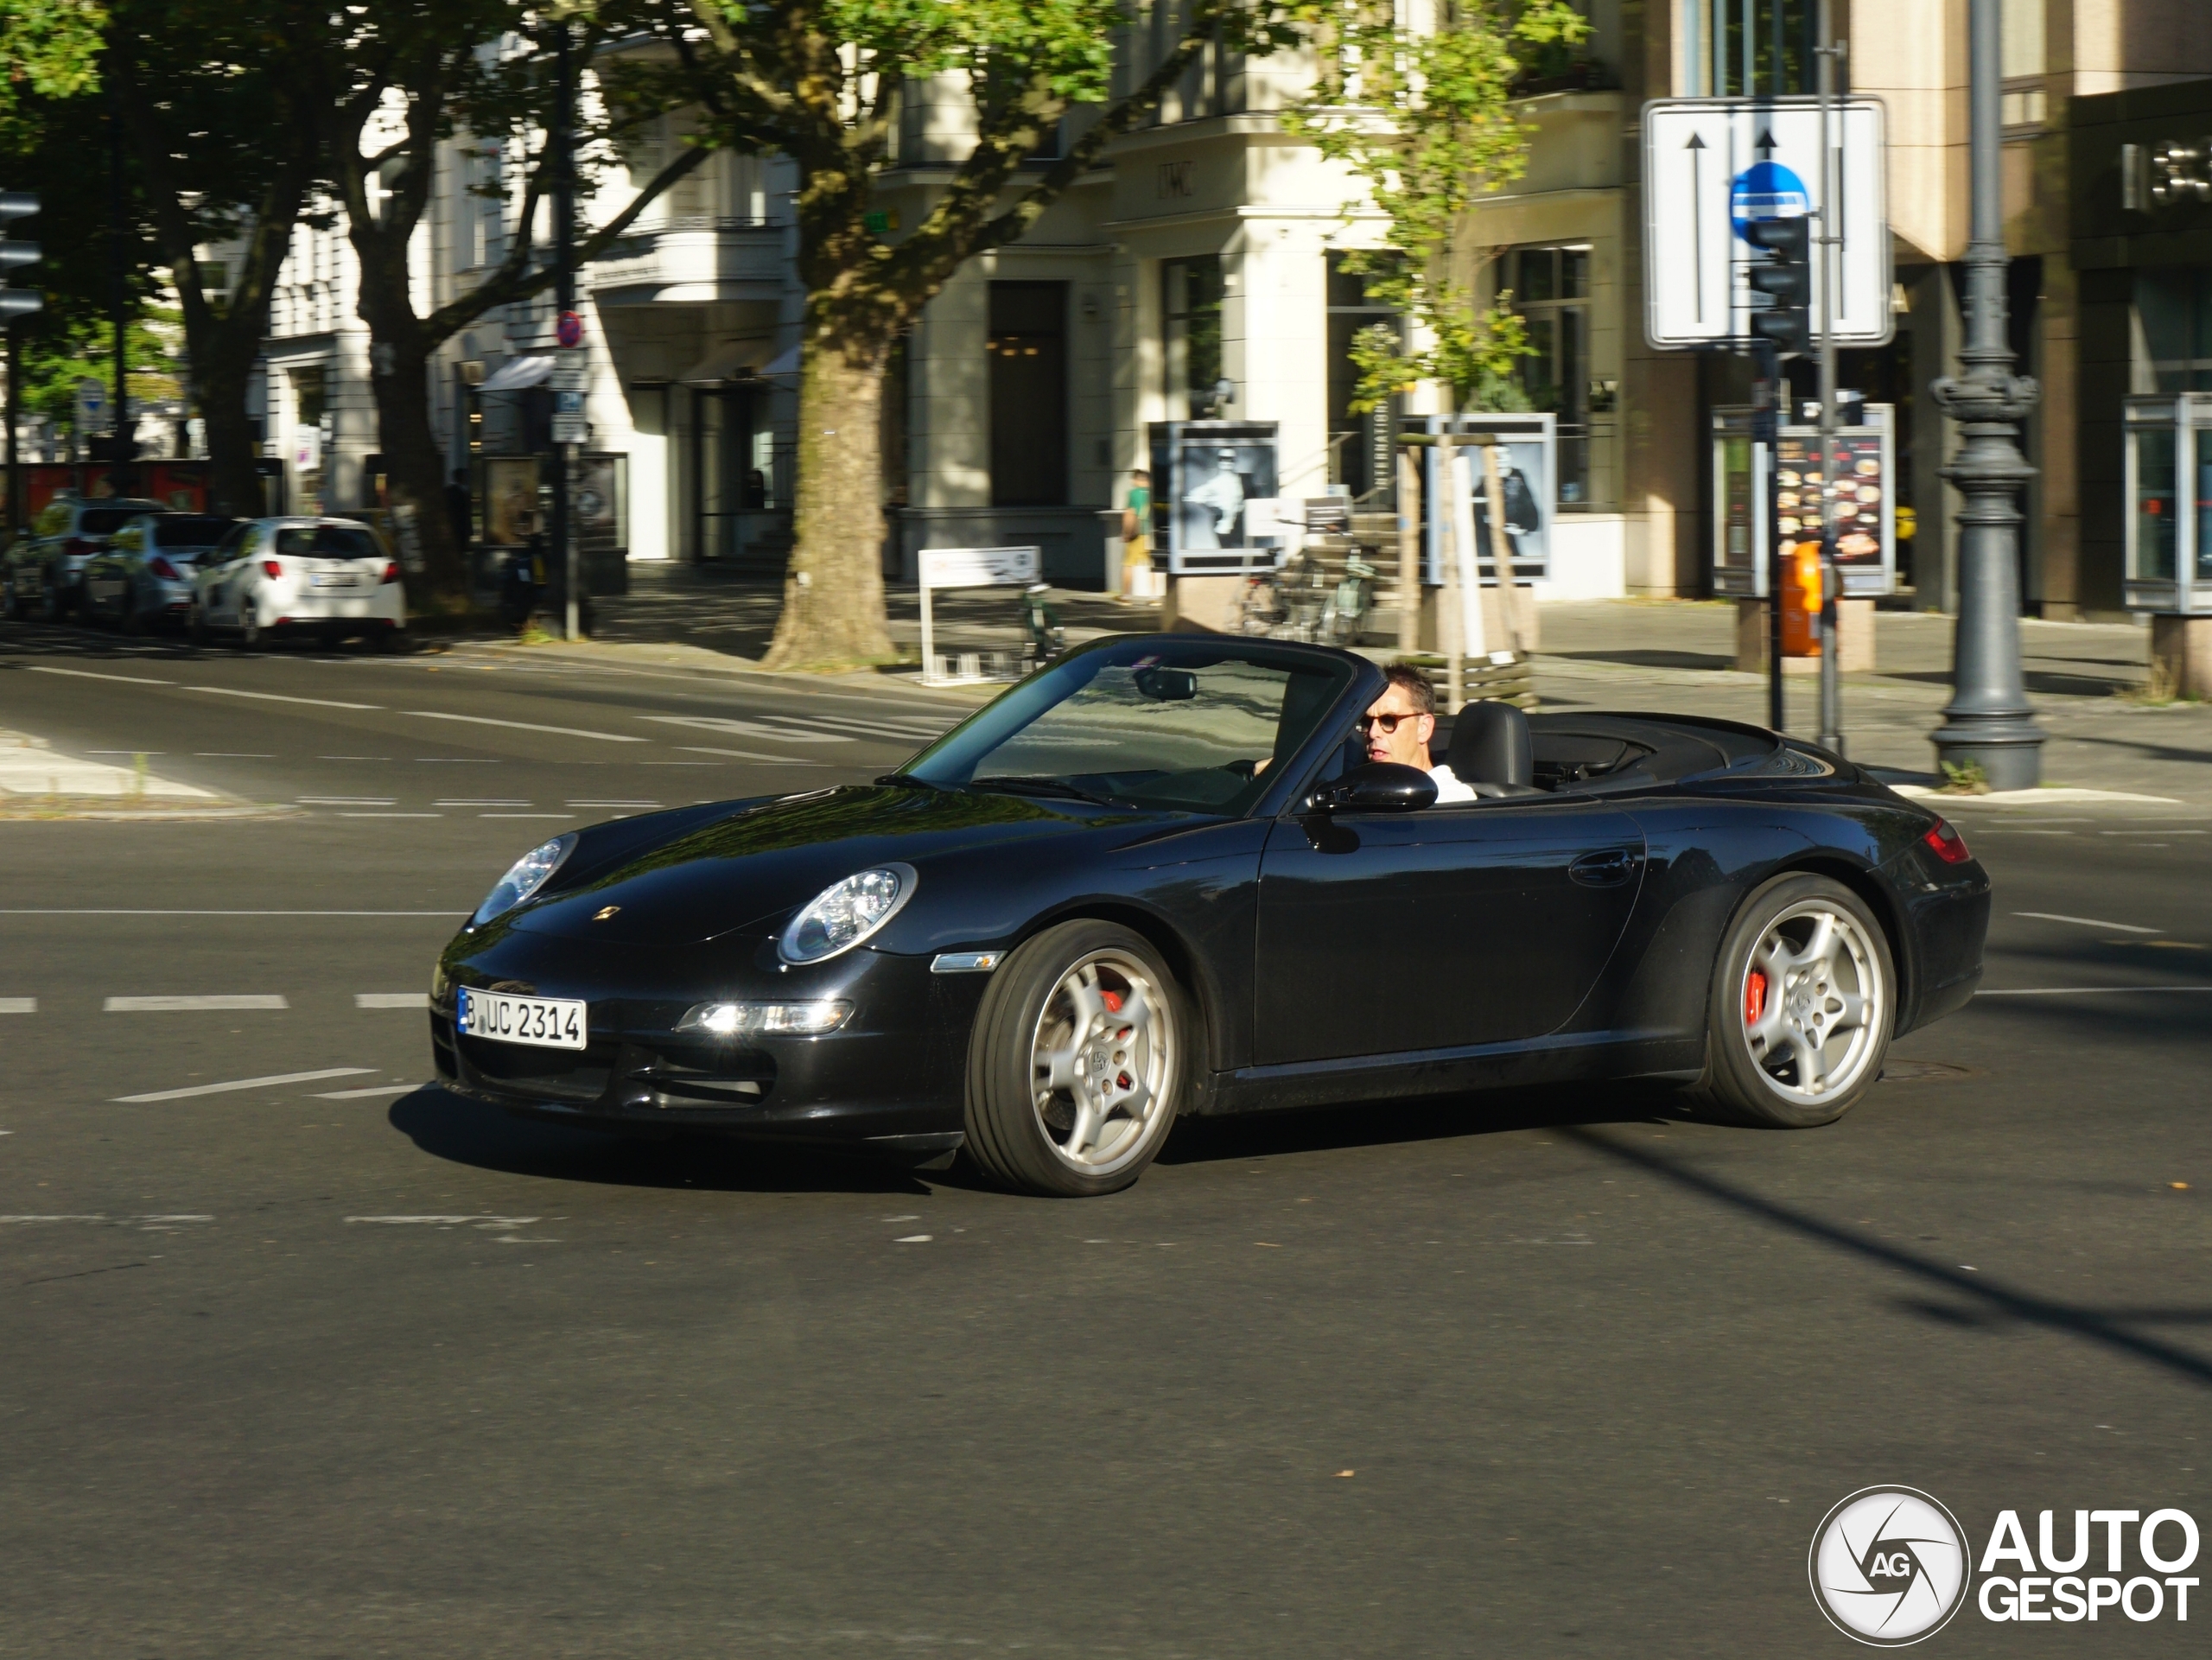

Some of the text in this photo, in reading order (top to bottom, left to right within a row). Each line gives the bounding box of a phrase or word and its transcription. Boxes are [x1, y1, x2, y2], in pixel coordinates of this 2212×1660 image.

[467, 996, 578, 1040] B UC 2314
